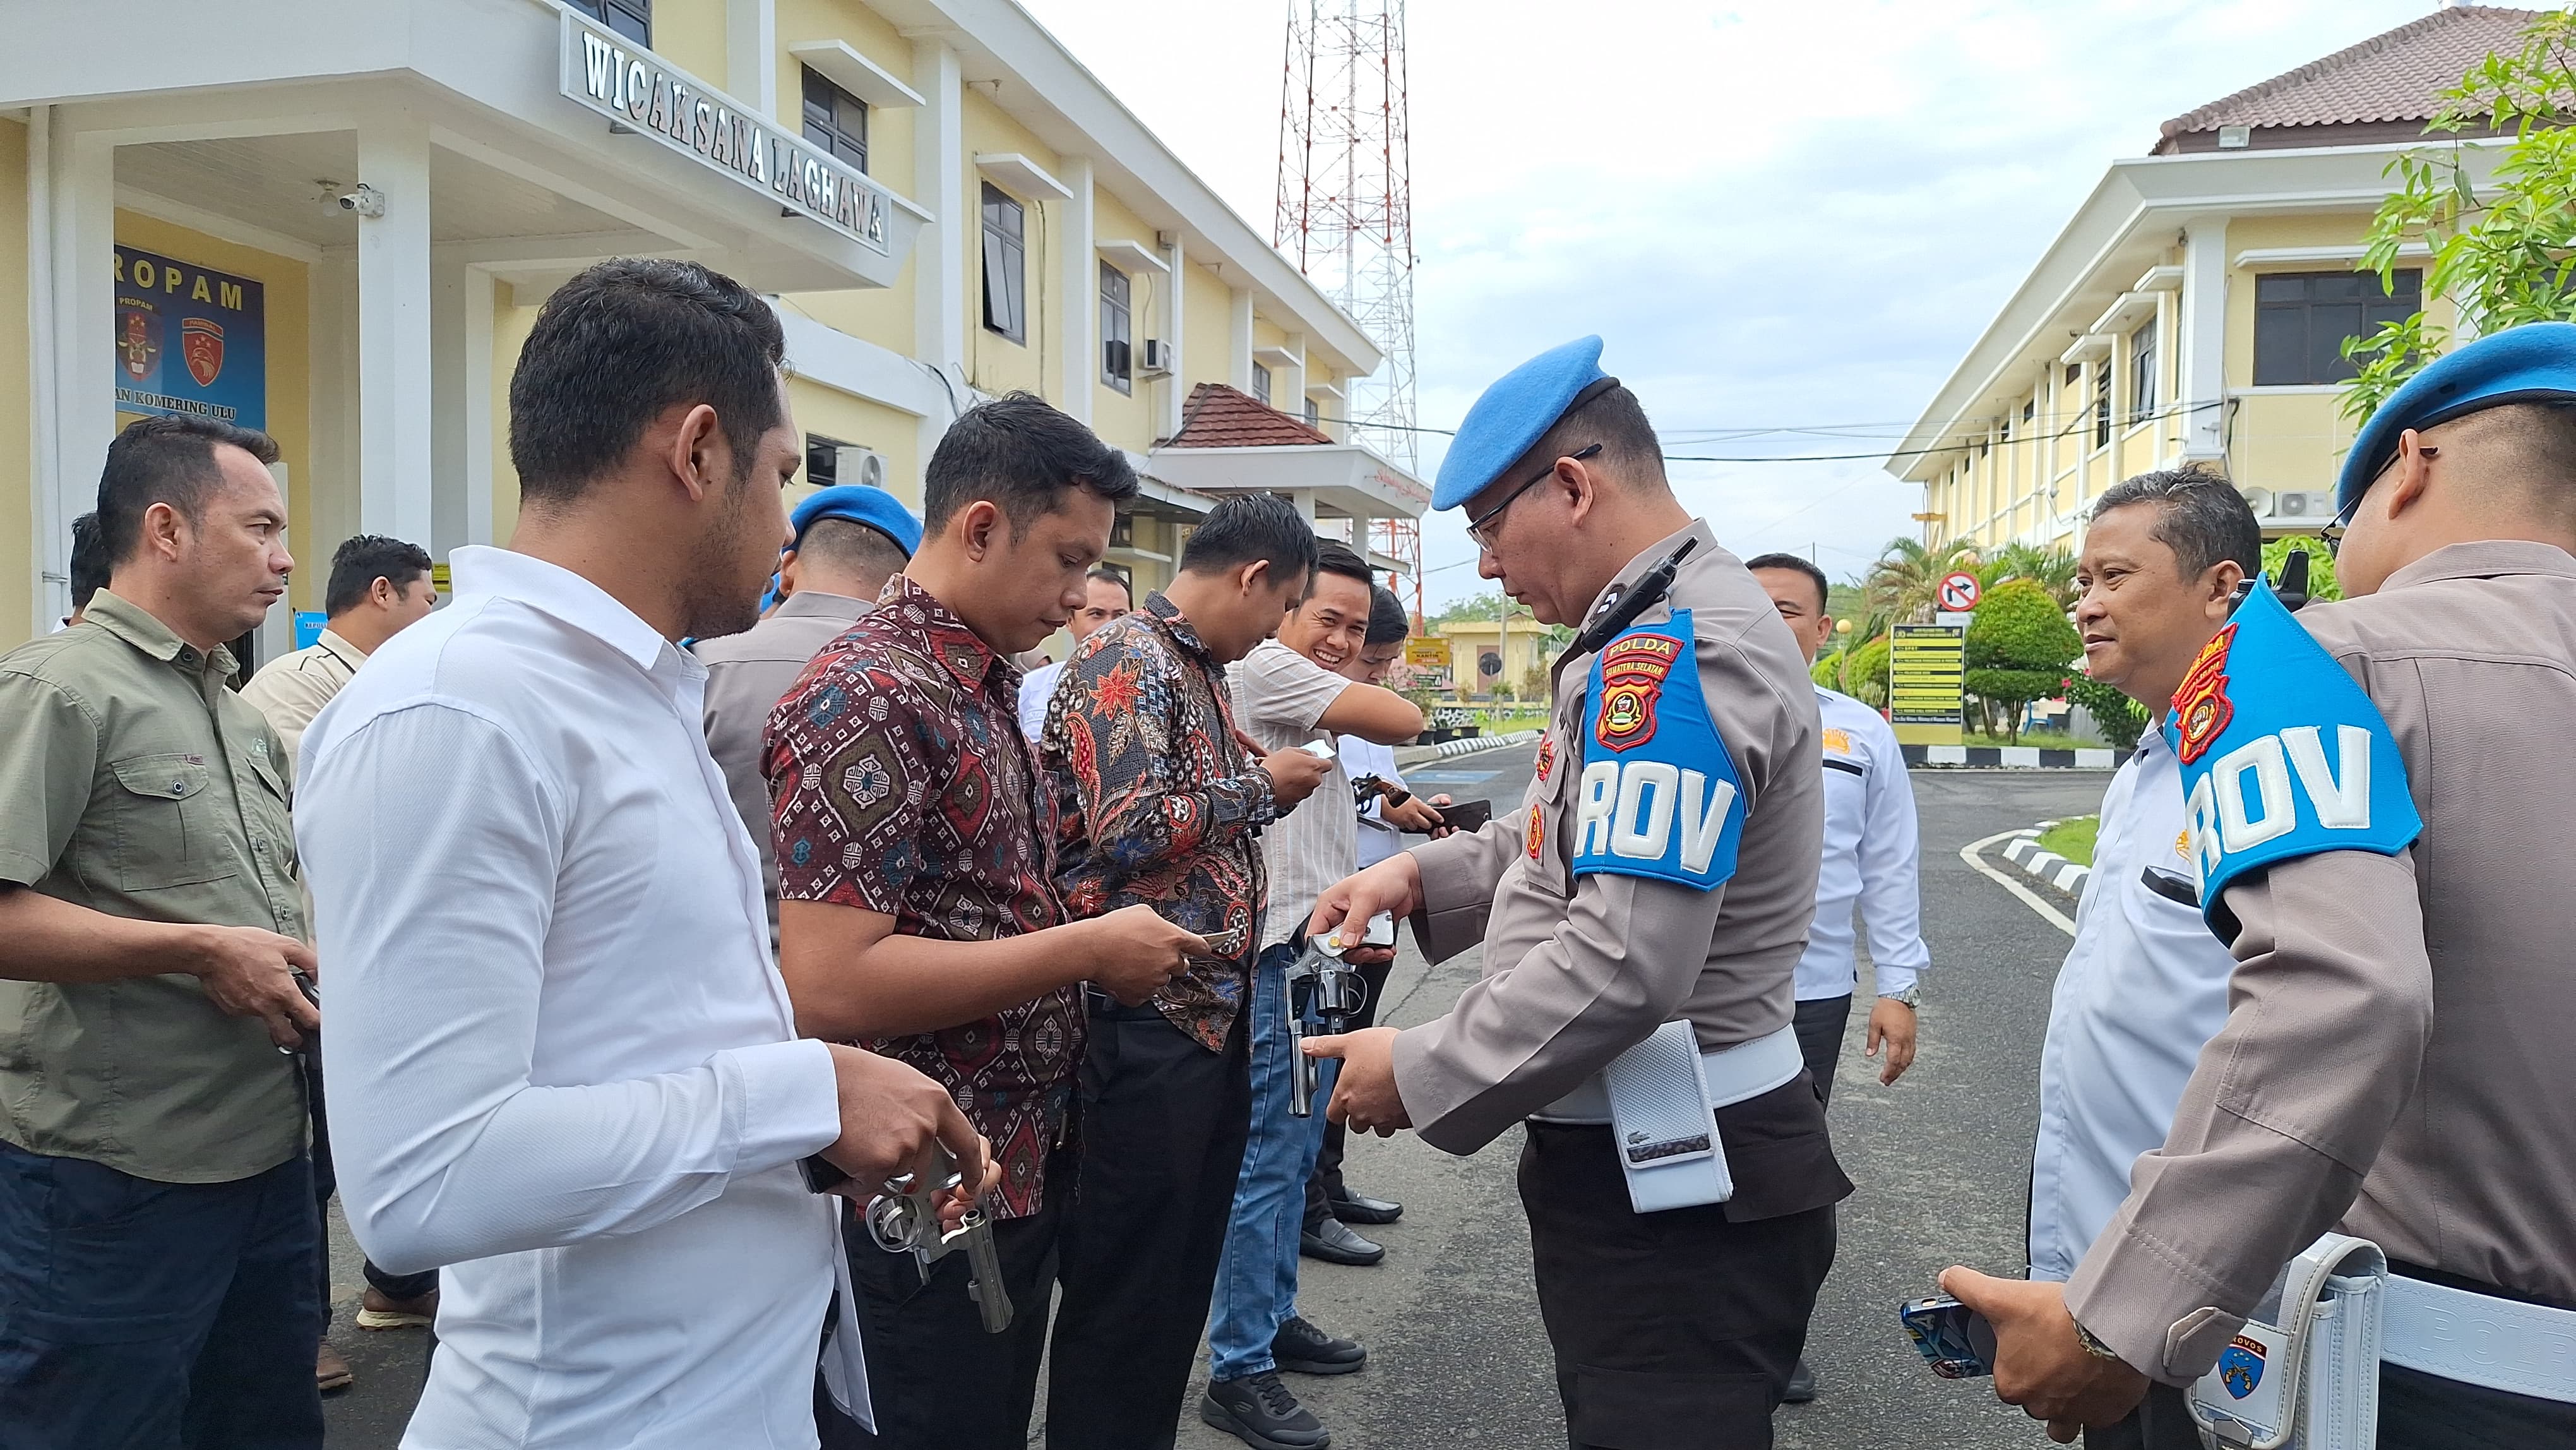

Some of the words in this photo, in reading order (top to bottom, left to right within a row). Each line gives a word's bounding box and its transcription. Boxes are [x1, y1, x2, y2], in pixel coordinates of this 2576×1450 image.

[582, 31, 766, 183] WICAKSANA
[772, 137, 883, 243] LAGHAWA
[119, 297, 153, 311] PROPAM
[134, 392, 208, 415] KOMERING
[211, 405, 236, 420] ULU
[1609, 638, 1671, 657] POLDA
[1606, 662, 1635, 677] SUMATERA
[1637, 662, 1664, 676] SELATAN
